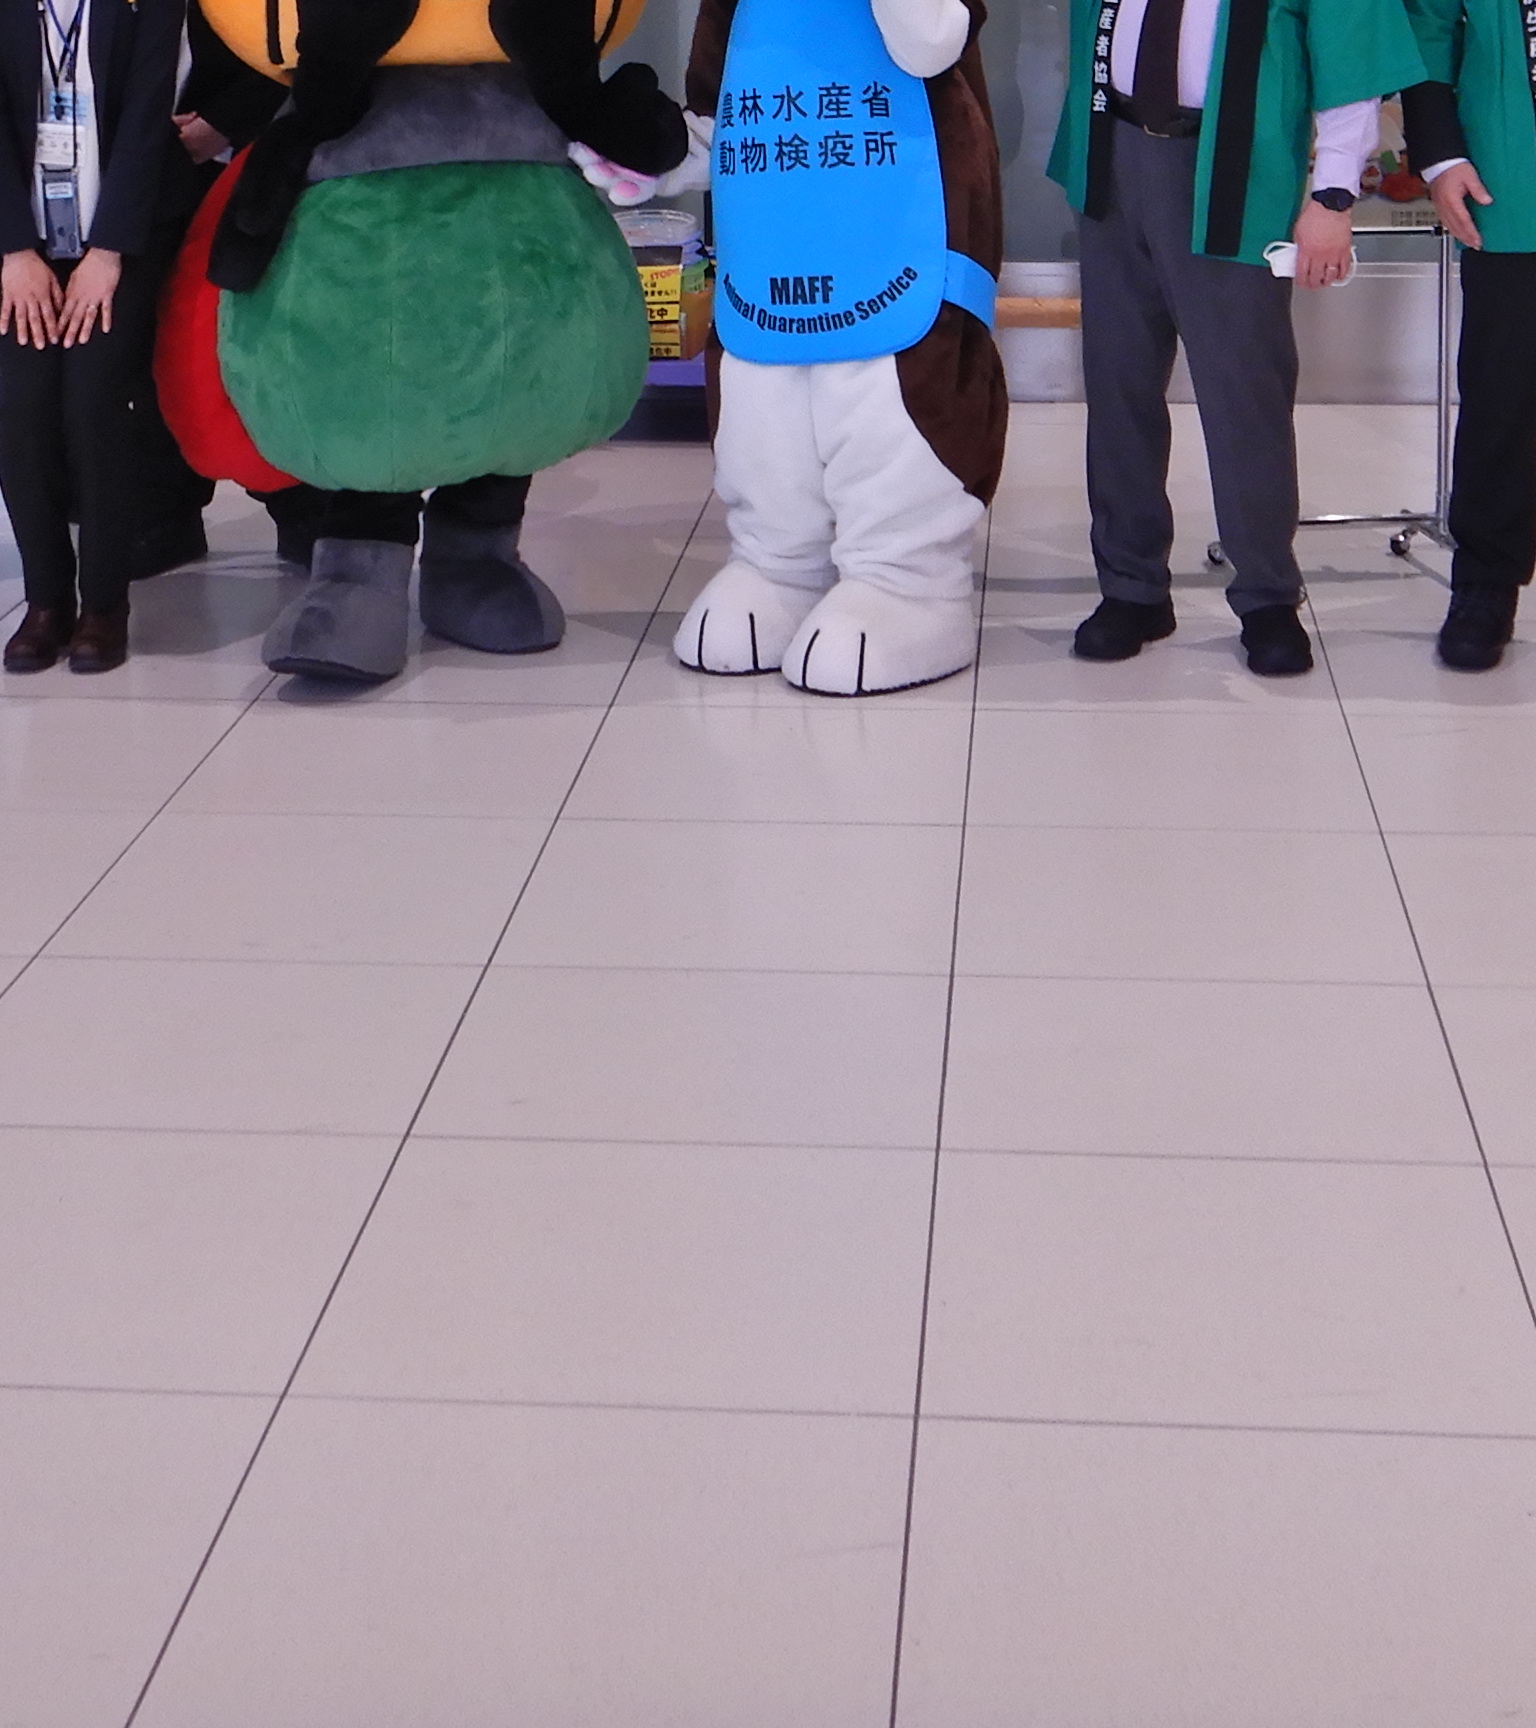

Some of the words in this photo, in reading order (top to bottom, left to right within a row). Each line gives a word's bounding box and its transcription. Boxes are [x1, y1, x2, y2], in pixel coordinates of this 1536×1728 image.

[719, 130, 898, 176] 動物検疫所
[723, 273, 756, 322] Animal
[756, 308, 856, 334] Quarantine
[854, 266, 918, 321] Service
[769, 275, 834, 305] MAFF
